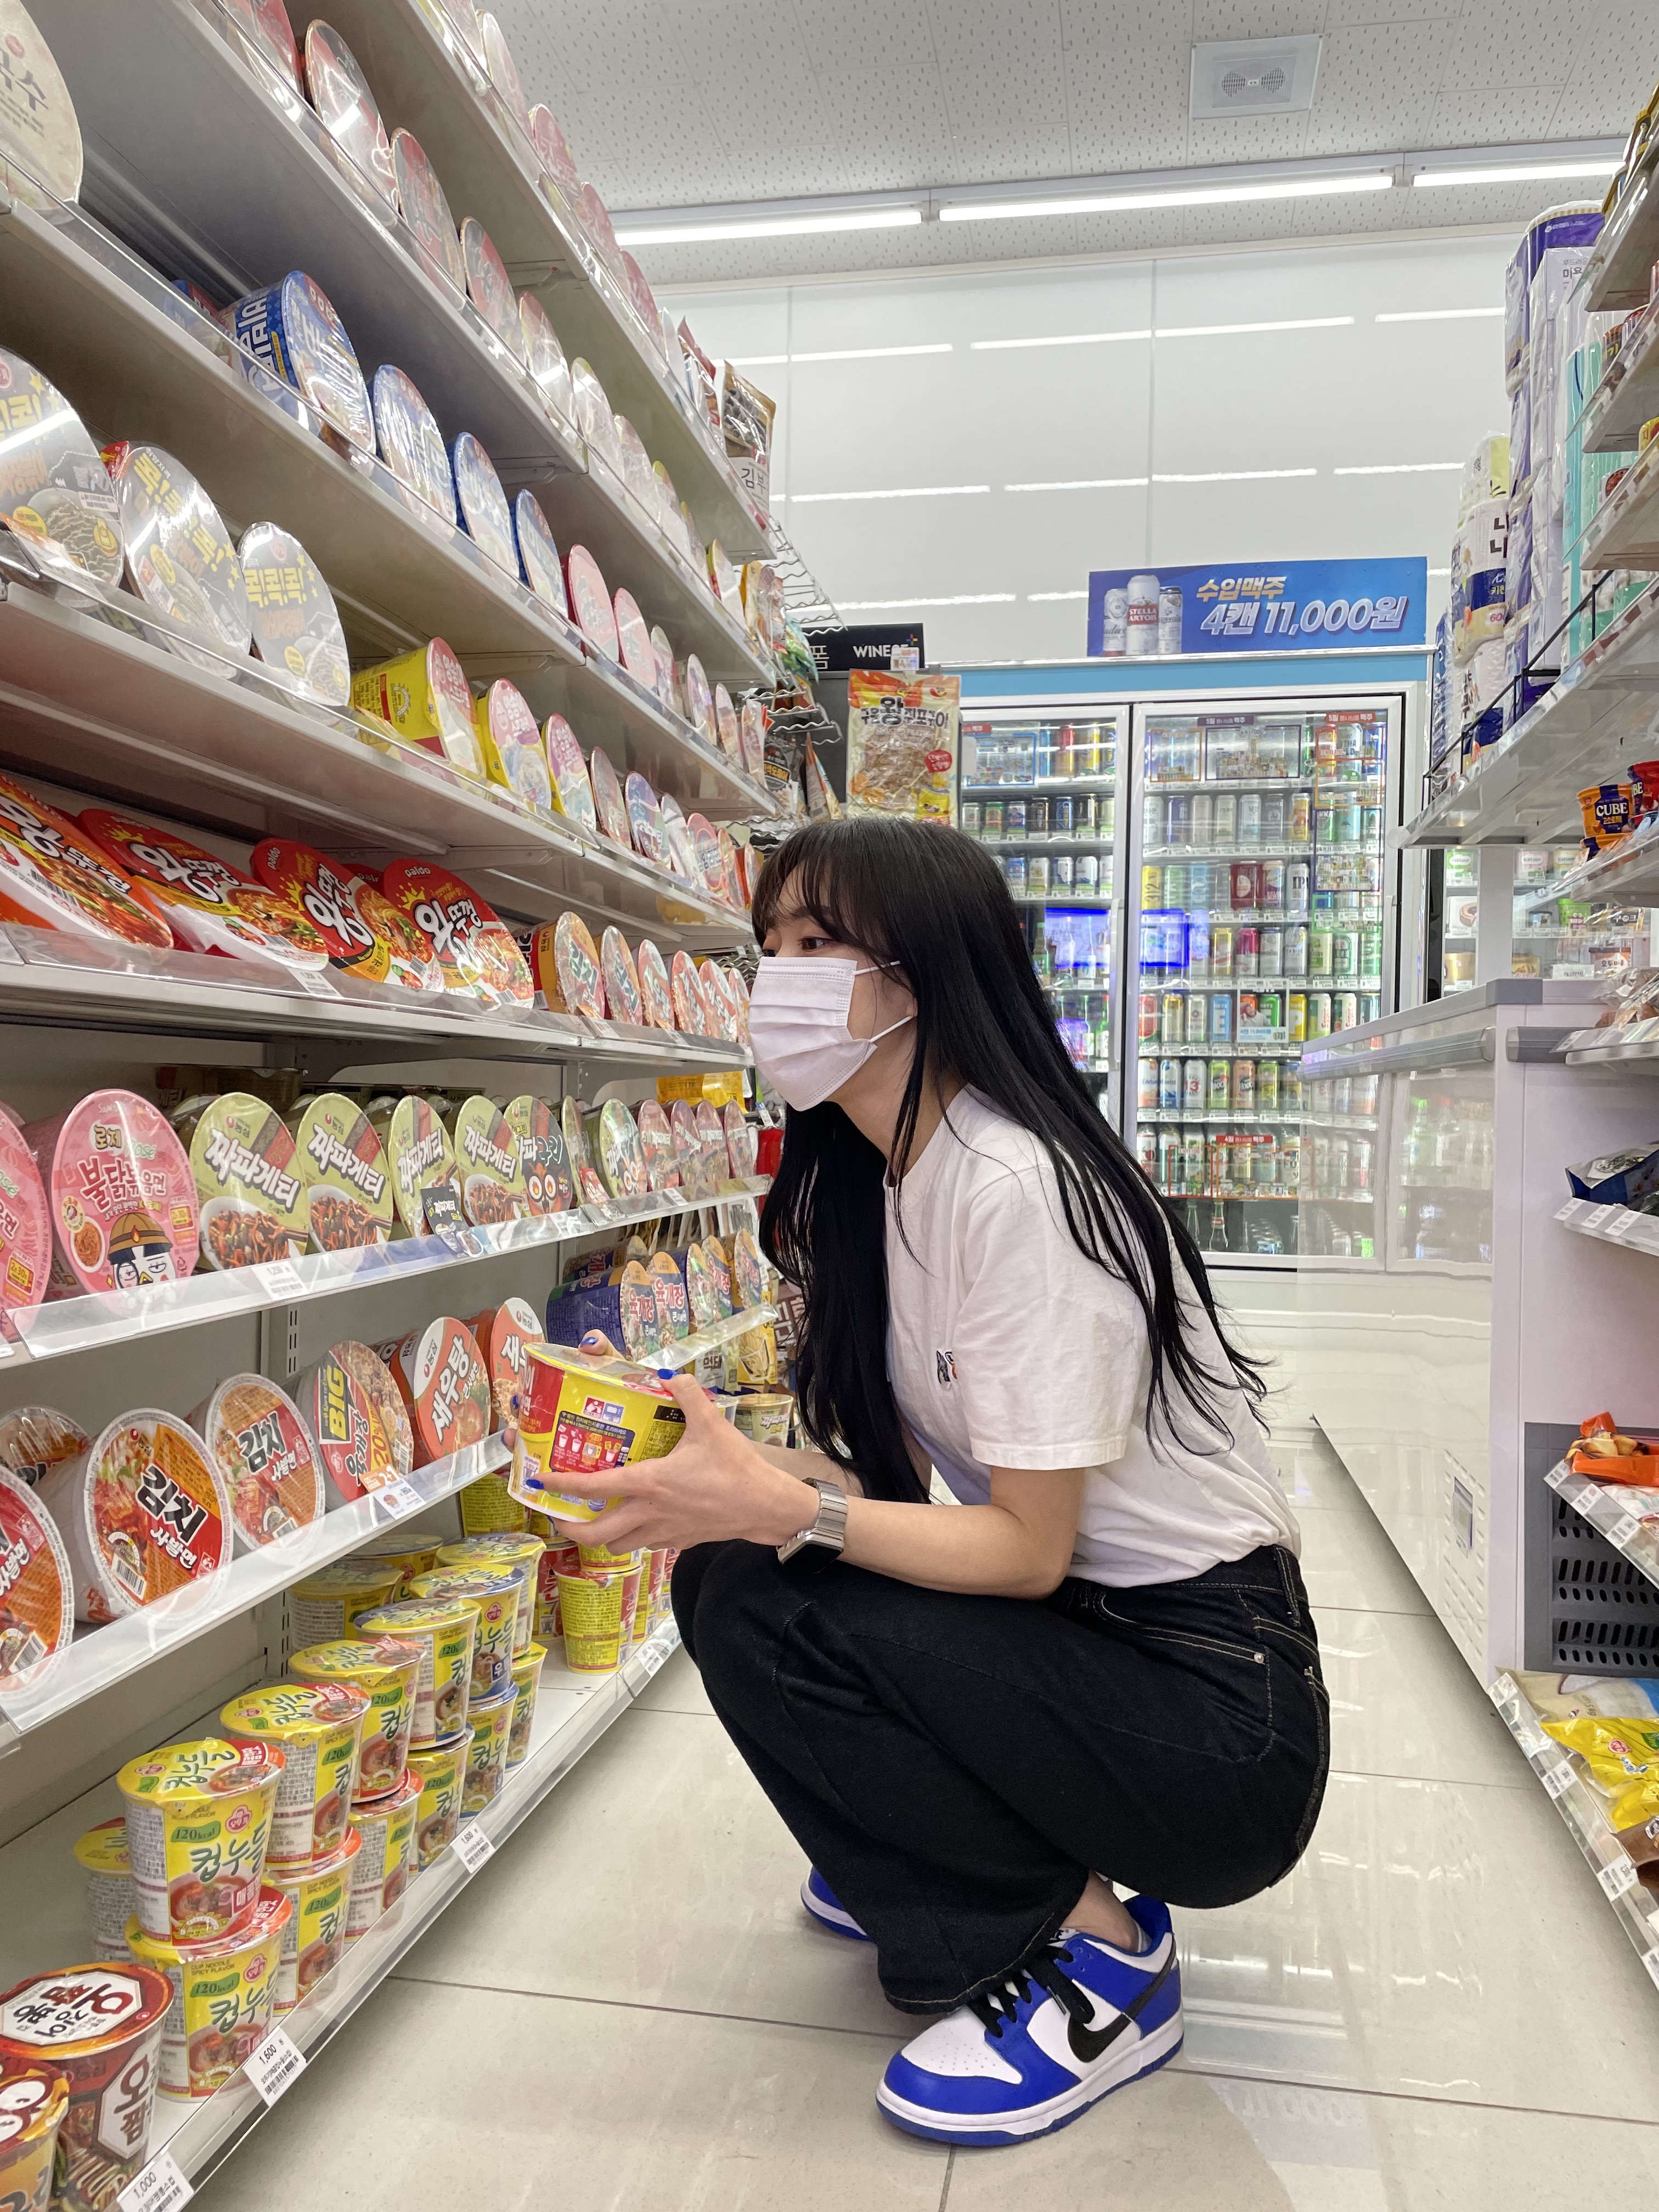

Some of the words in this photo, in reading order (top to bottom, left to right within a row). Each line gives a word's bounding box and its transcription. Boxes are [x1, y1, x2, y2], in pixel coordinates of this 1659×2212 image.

[1196, 577, 1286, 602] 수입맥주
[1200, 601, 1260, 635] 4캔
[1264, 596, 1408, 636] 11,000원
[1632, 782, 1644, 796] BE
[1596, 803, 1628, 816] CUBE
[267, 847, 281, 870] paldo
[405, 866, 431, 878] paldo
[127, 841, 242, 904] 왕뚜껑
[303, 862, 375, 949] 왕뚜껑
[94, 1124, 122, 1151] 로제
[234, 1120, 250, 1138] 농심
[332, 1119, 345, 1135] 농심
[307, 1125, 385, 1199] 짜파게티
[397, 1128, 445, 1195] 짜파게티
[464, 1125, 516, 1180] 짜파게티
[204, 1127, 301, 1208] 짜파게티
[629, 1290, 654, 1322] 육개장
[654, 1278, 685, 1309] 육개장
[523, 1318, 532, 1329] 농심
[326, 1365, 346, 1441] BIG
[431, 1336, 471, 1444] 새우탕
[238, 1412, 286, 1474] 김치
[272, 1454, 297, 1481] 사발면
[379, 1465, 400, 1485] 2+1
[137, 1465, 207, 1545] 김치
[150, 1527, 198, 1571] 사발면
[176, 1829, 216, 1839] 120kcal
[230, 1815, 249, 1828] 오뚜기
[189, 1820, 266, 1883] 컵누들
[205, 1960, 230, 1969] NOODLE
[208, 1964, 234, 1973] FLAVOR
[248, 1967, 264, 1978] 오뚜기
[195, 1981, 234, 1994] 120kcal
[259, 2046, 275, 2064] 1,600
[133, 2171, 156, 2198] 1,000
